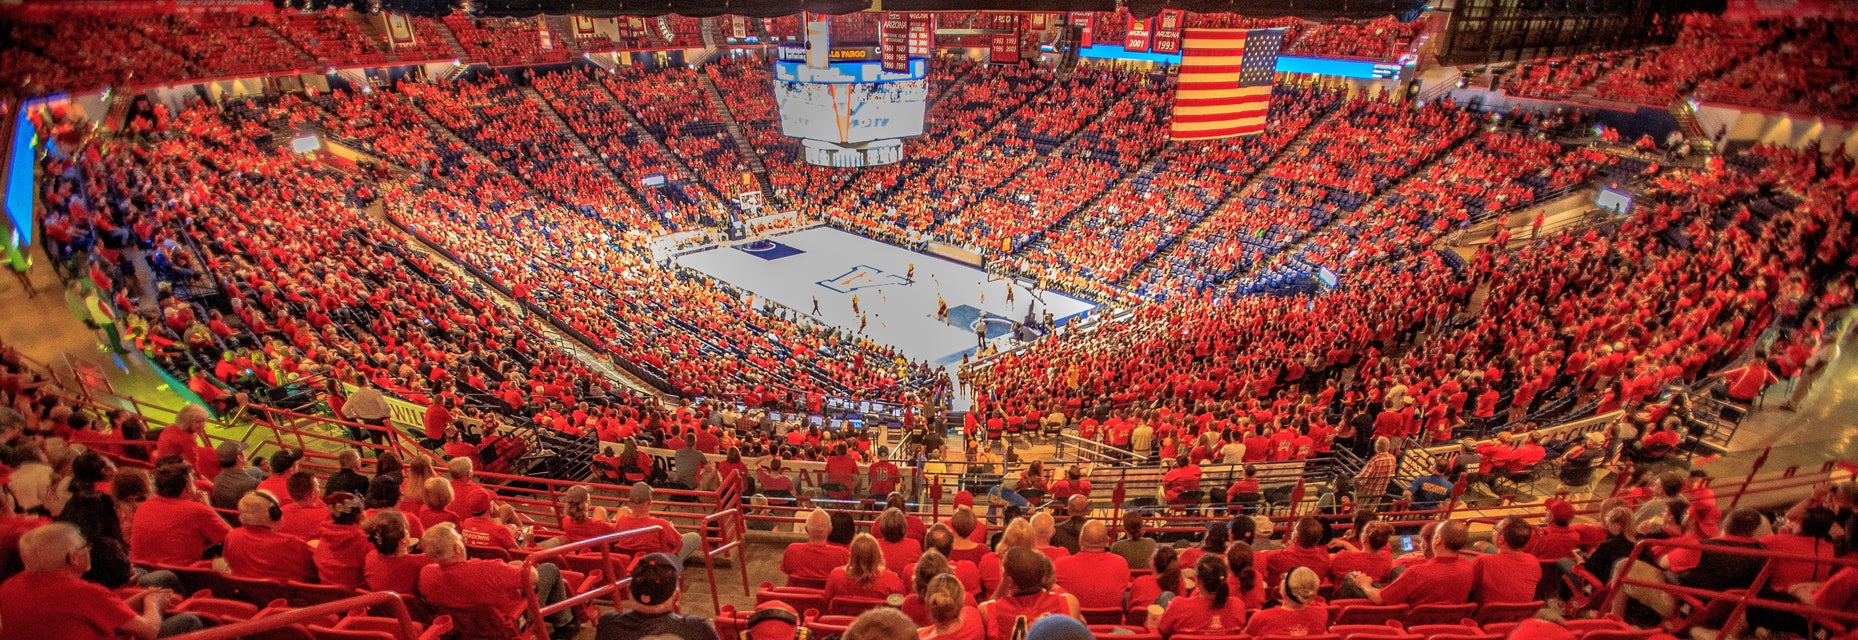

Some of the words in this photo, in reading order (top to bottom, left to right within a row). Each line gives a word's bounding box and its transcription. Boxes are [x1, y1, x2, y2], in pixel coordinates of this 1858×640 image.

[883, 20, 907, 29] ARIZONA
[1155, 30, 1179, 38] ARIZONA
[1128, 39, 1145, 48] 2001
[1157, 41, 1175, 50] 1993
[841, 50, 866, 58] FARGO
[390, 403, 426, 426] WIL
[877, 467, 888, 481] 16
[1422, 482, 1448, 495] SECURITY
